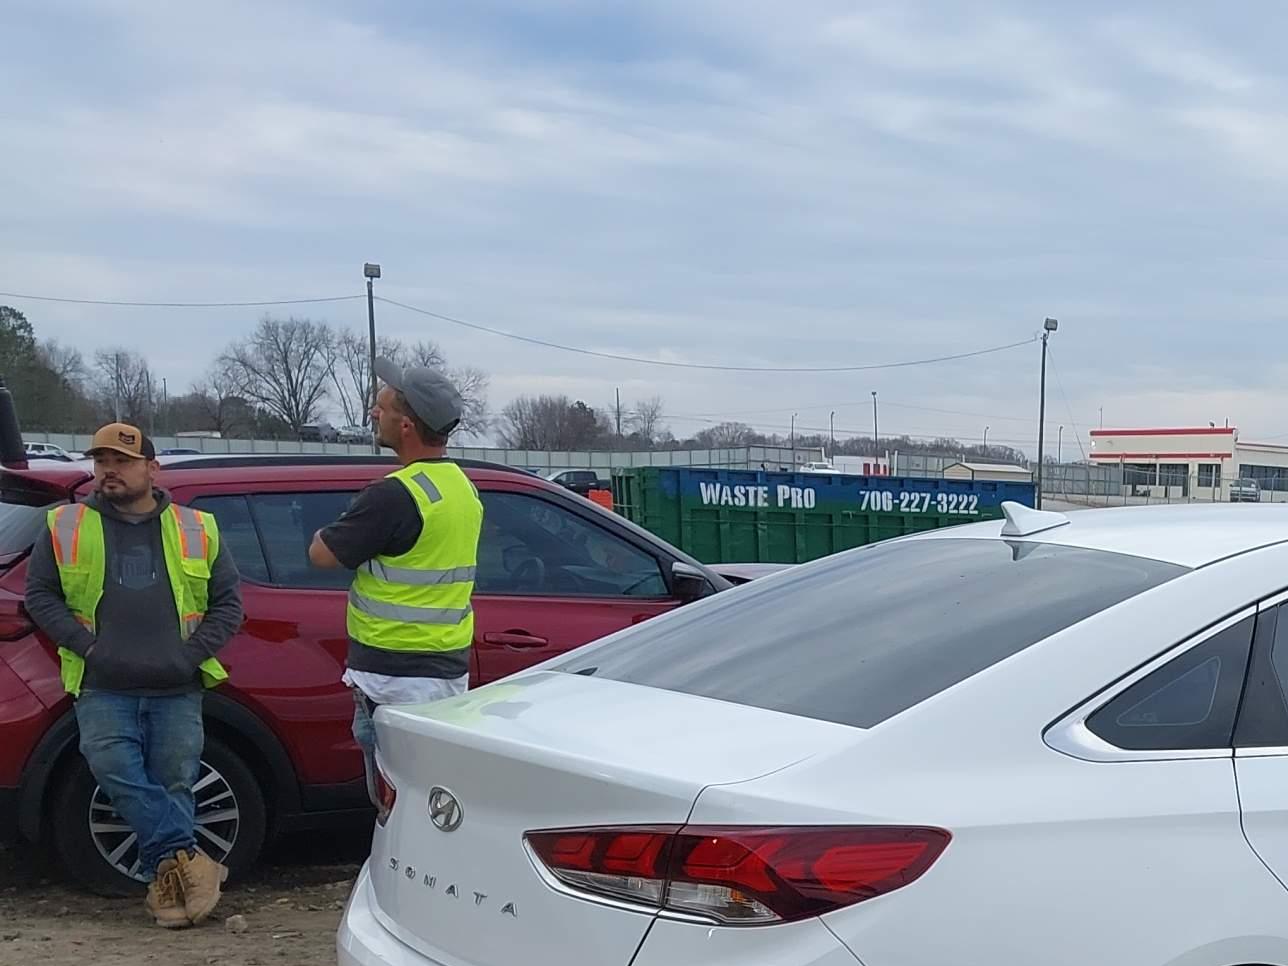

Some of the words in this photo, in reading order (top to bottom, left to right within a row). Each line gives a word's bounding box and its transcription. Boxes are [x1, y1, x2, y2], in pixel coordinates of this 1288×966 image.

[699, 482, 769, 508] WASTE
[777, 484, 816, 509] PRO
[859, 490, 979, 515] 706-227-3222
[389, 857, 518, 918] SONATA
